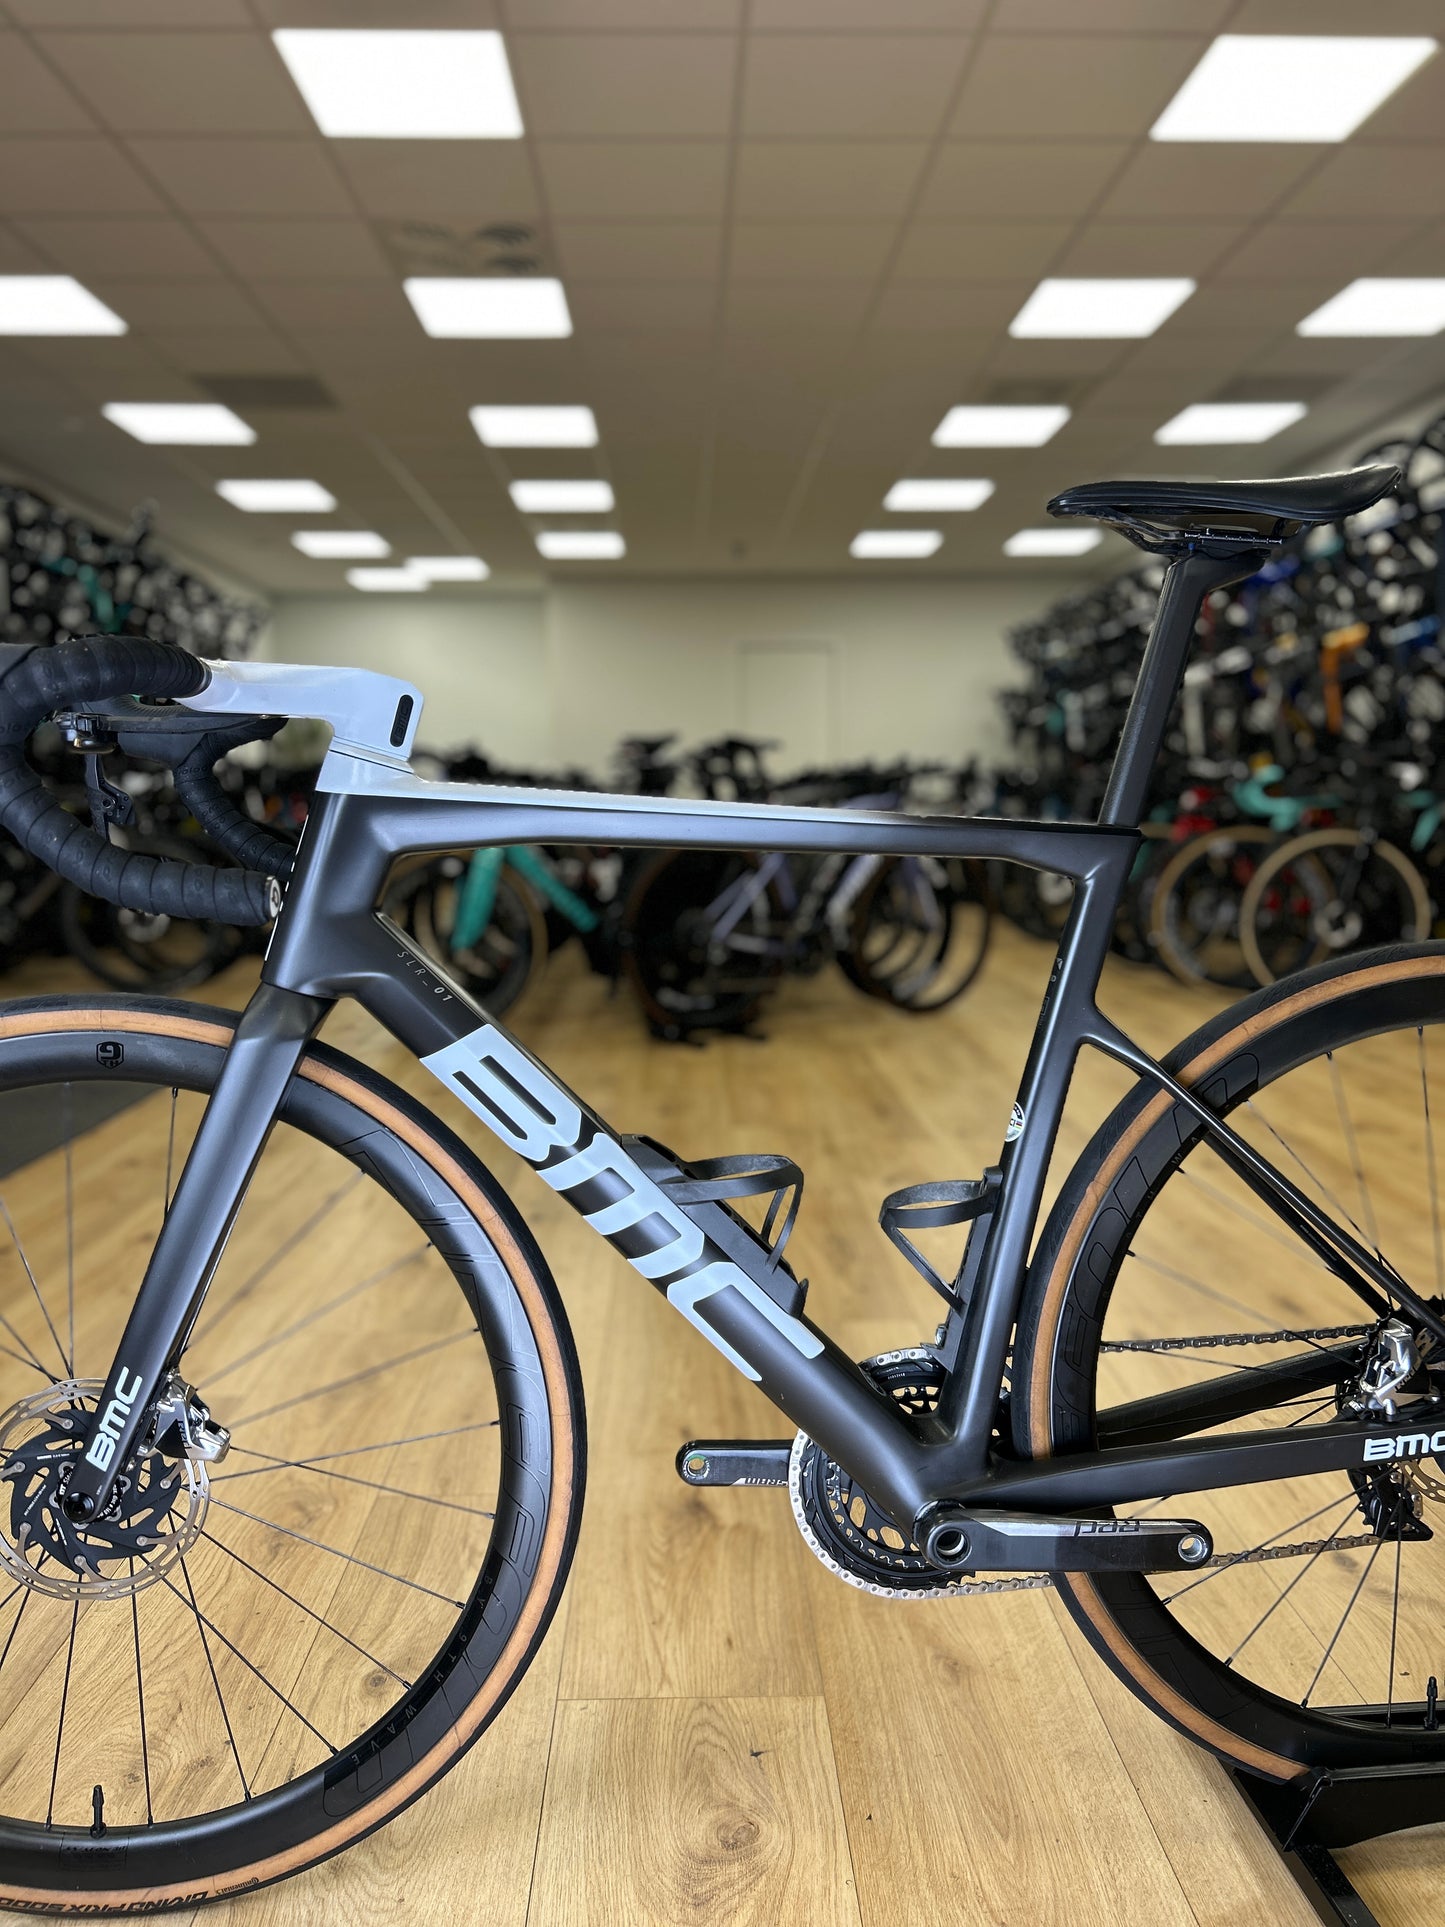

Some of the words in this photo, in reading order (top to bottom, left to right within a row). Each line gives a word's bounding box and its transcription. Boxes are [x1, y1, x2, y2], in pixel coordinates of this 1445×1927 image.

[419, 1024, 825, 1382] BMC
[85, 1366, 143, 1472] BMC
[433, 1632, 467, 1683] 9TH
[351, 1703, 417, 1766] WAVE
